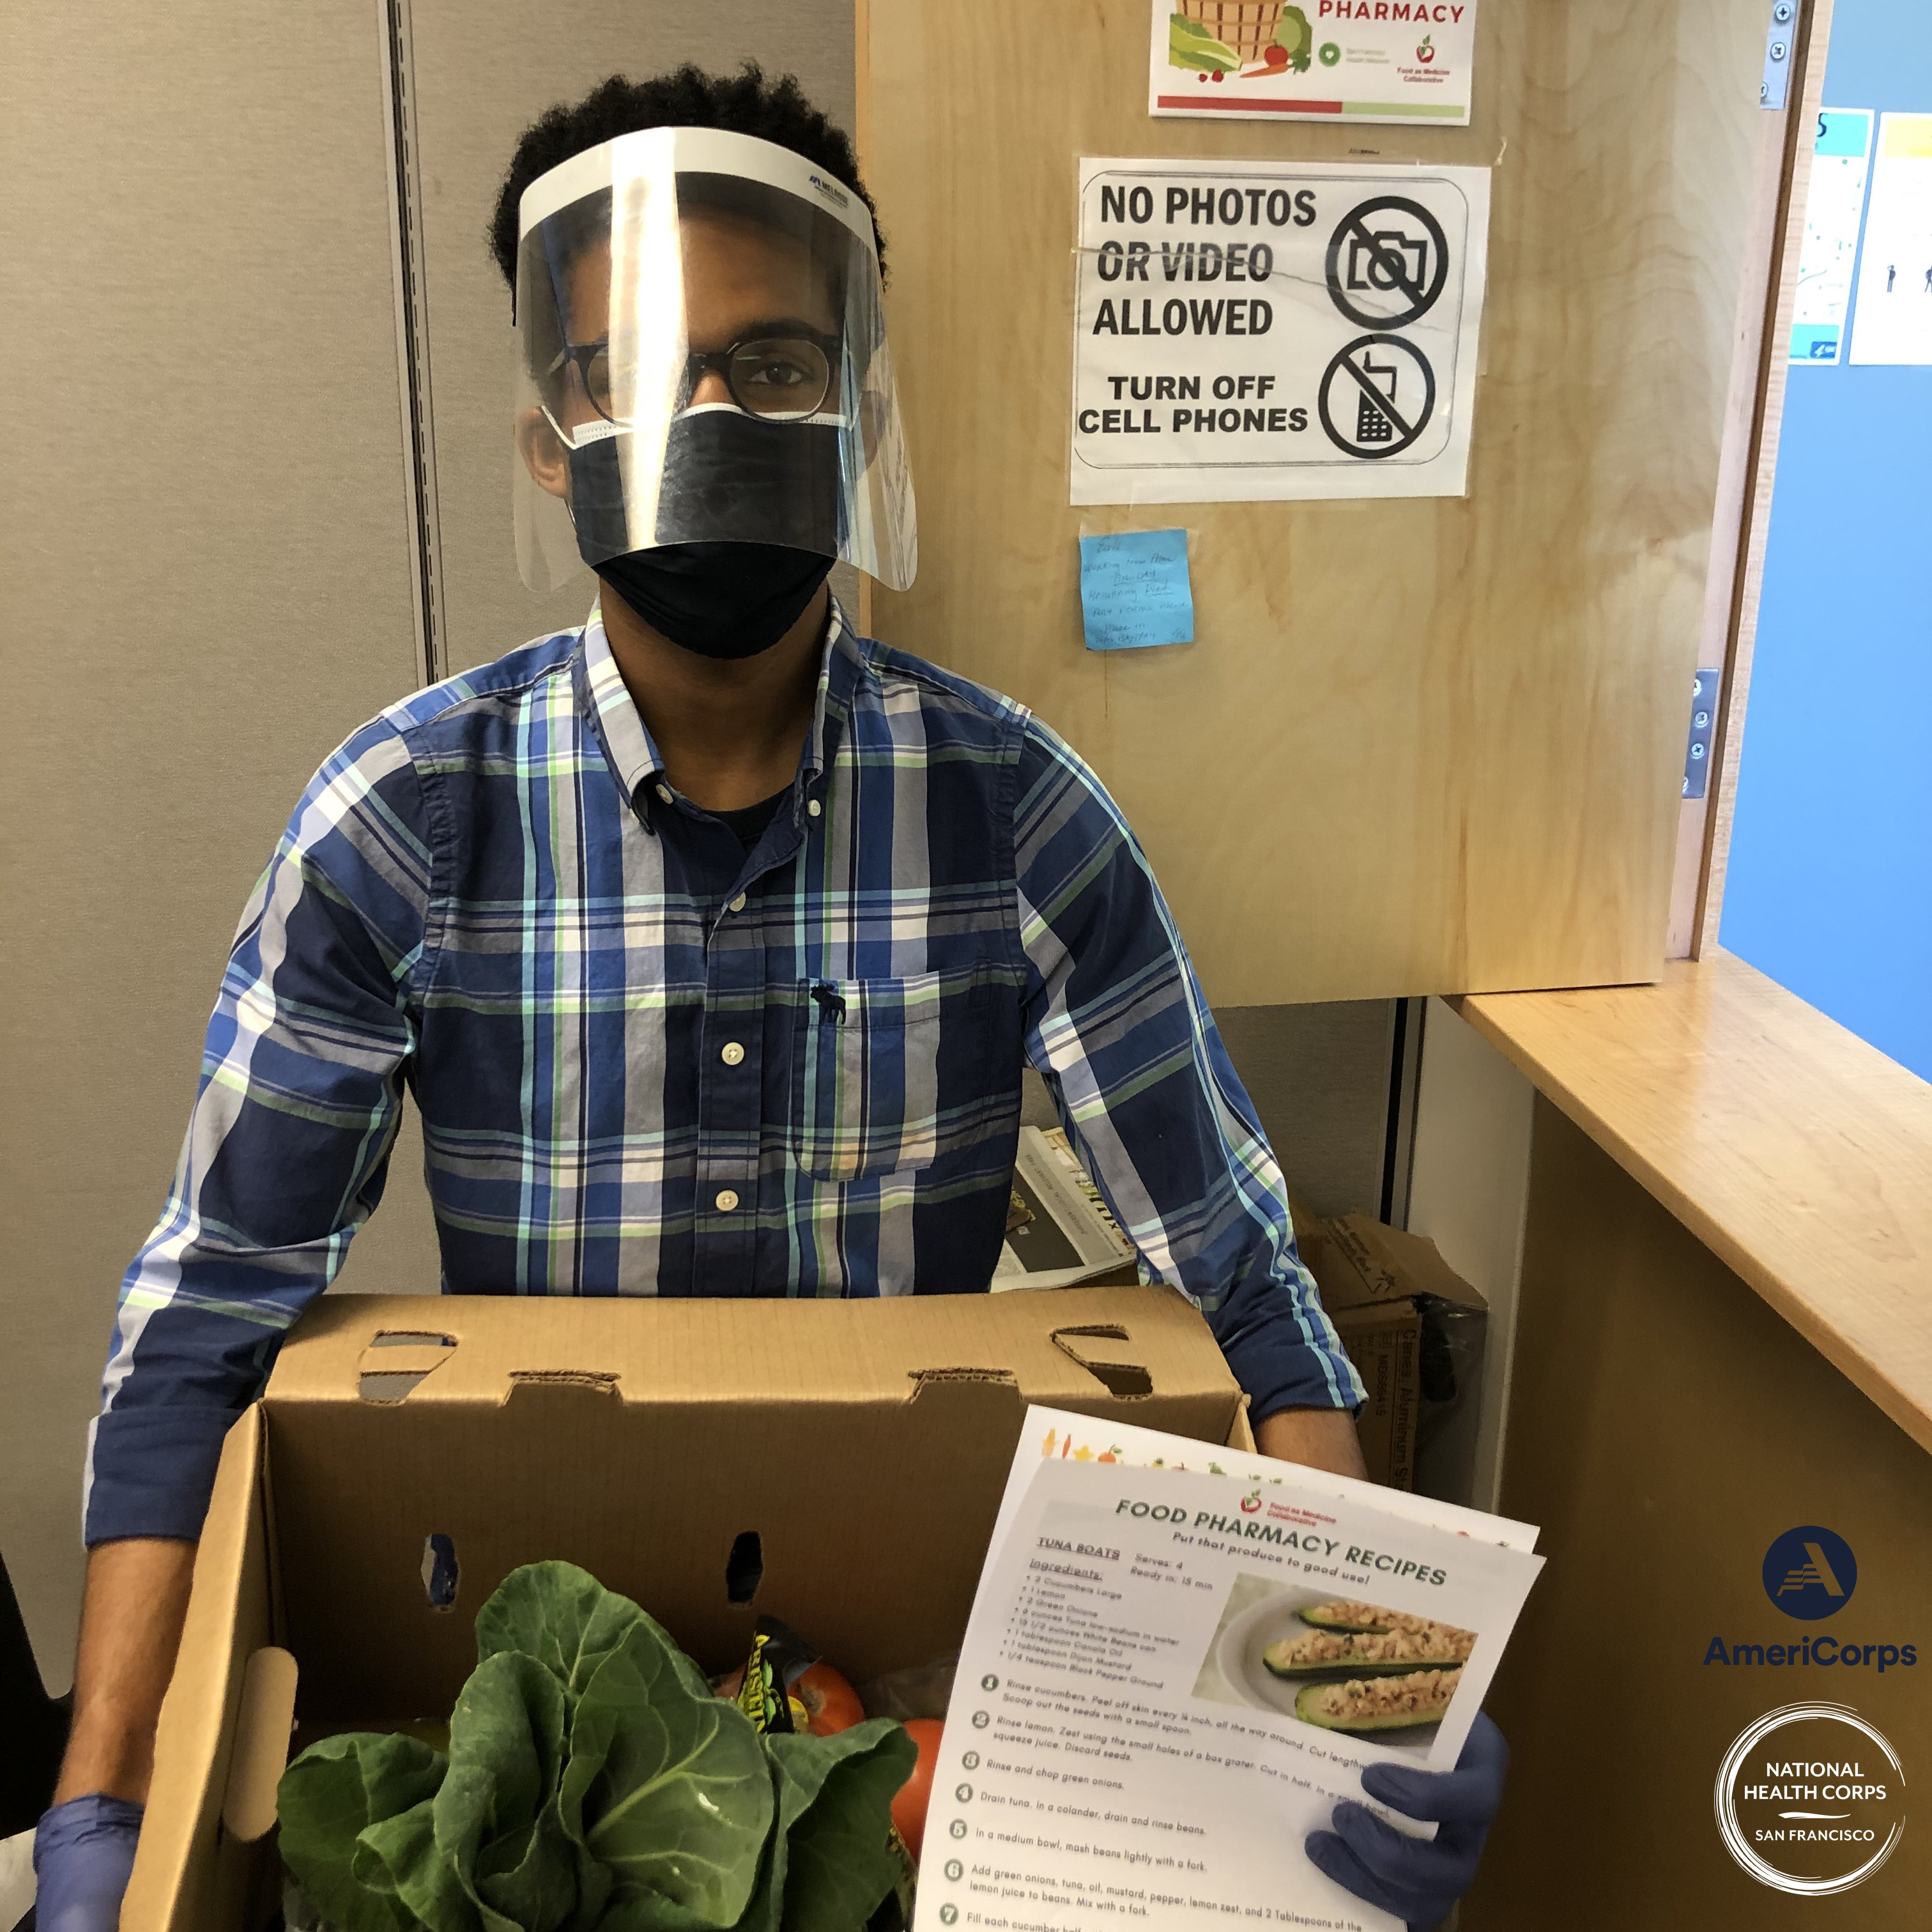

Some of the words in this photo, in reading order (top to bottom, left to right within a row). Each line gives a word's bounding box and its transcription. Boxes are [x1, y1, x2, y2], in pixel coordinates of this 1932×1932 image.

[1319, 1, 1464, 23] PHARMACY
[1101, 185, 1153, 225] NO
[1165, 187, 1317, 226] PHOTOS
[1098, 240, 1150, 282] OR
[1162, 241, 1273, 282] VIDEO
[1093, 298, 1273, 335] ALLOWED
[1108, 376, 1200, 400] TURN
[1213, 376, 1275, 400] OFF
[1079, 410, 1160, 433] CELL
[1173, 408, 1308, 433] PHONES
[1036, 1537, 1071, 1552] TUNA
[1076, 1544, 1120, 1560] BOATS
[1116, 1499, 1187, 1523] FOOD
[1193, 1511, 1340, 1556] PHARMACY
[1345, 1545, 1446, 1585] RECIPES
[1172, 1531, 1193, 1544] Put
[1198, 1537, 1225, 1550] that
[1227, 1544, 1282, 1564] produce
[1287, 1556, 1300, 1567] to
[1303, 1563, 1338, 1576] good
[1342, 1571, 1370, 1585] use!
[1130, 1566, 1162, 1581] Ready
[1181, 1576, 1192, 1586] 15
[1194, 1581, 1213, 1590] min
[1176, 1561, 1183, 1570] 4
[1142, 1632, 1151, 1640] in
[1002, 1693, 1033, 1708] Scoop
[1036, 1700, 1052, 1709] out
[1055, 1703, 1070, 1712] the
[1073, 1706, 1100, 1717] seeds
[1103, 1711, 1123, 1722] with
[1135, 1717, 1159, 1729] small
[1007, 1679, 1031, 1691] Rinse
[1092, 1695, 1112, 1706] Peel
[1115, 1700, 1130, 1709] off
[1131, 1703, 1149, 1713] skin
[1152, 1708, 1177, 1721] every
[1216, 1720, 1228, 1729] all
[1230, 1723, 1245, 1733] the
[1248, 1728, 1268, 1739] way
[1309, 1745, 1326, 1758] Cut
[993, 1731, 1032, 1744] squeeze
[1064, 1742, 1100, 1756] Discard
[1103, 1748, 1133, 1761] seeds.
[997, 1715, 1022, 1728] Rinse
[1059, 1726, 1080, 1738] Zest
[1084, 1732, 1107, 1744] using
[1111, 1735, 1126, 1746] the
[1129, 1739, 1154, 1751] small
[1156, 1743, 1181, 1756] holes
[1183, 1749, 1193, 1757] of
[1206, 1752, 1222, 1763] box
[1260, 1764, 1278, 1775] Cut
[1280, 1771, 1289, 1781] in
[1316, 1785, 1324, 1795] In
[986, 1759, 1011, 1771] Rinse
[1015, 1765, 1032, 1775] and
[1036, 1767, 1059, 1780] chop
[1062, 1773, 1089, 1784] green
[1092, 1778, 1124, 1790] onions.
[981, 1791, 1006, 1804] Drain
[1009, 1796, 1032, 1808] tuna.
[1036, 1800, 1045, 1810] In
[1047, 1804, 1054, 1812] a
[1056, 1804, 1101, 1820] colander,
[1104, 1810, 1128, 1823] drain
[1131, 1816, 1149, 1827] and
[1151, 1818, 1174, 1830] rinse
[1176, 1821, 1206, 1836] beans.
[976, 1827, 984, 1838] In
[987, 1831, 994, 1840] a
[997, 1832, 1034, 1846] medium
[1037, 1836, 1062, 1851] bowl,
[1066, 1842, 1090, 1854] mash
[1092, 1845, 1121, 1859] beans
[1124, 1847, 1153, 1865] lightly
[1156, 1855, 1174, 1867] with
[1177, 1860, 1184, 1868] a
[1186, 1858, 1207, 1872] fork.
[970, 1880, 999, 1894] lemon
[1002, 1885, 1025, 1898] juice
[1029, 1890, 1038, 1900] to
[1042, 1891, 1072, 1905] beans.
[1077, 1896, 1092, 1908] Mix
[1096, 1900, 1116, 1912] with
[1128, 1903, 1149, 1916] fork.
[972, 1864, 991, 1876] Add
[994, 1867, 1022, 1881] green
[1025, 1874, 1058, 1887] onions,
[1062, 1878, 1085, 1891] tuna,
[1089, 1882, 1103, 1894] oil,
[1107, 1886, 1147, 1901] mustard,
[1150, 1892, 1186, 1906] pepper,
[1190, 1896, 1217, 1910] lemon
[1220, 1903, 1241, 1915] zest,
[1245, 1907, 1262, 1917] and
[1266, 1908, 1272, 1919] 2
[1275, 1910, 1331, 1929] Tablespoons
[1335, 1919, 1344, 1929] of
[1347, 1920, 1362, 1932] the
[967, 1912, 981, 1923] Fill
[985, 1916, 1008, 1928] each
